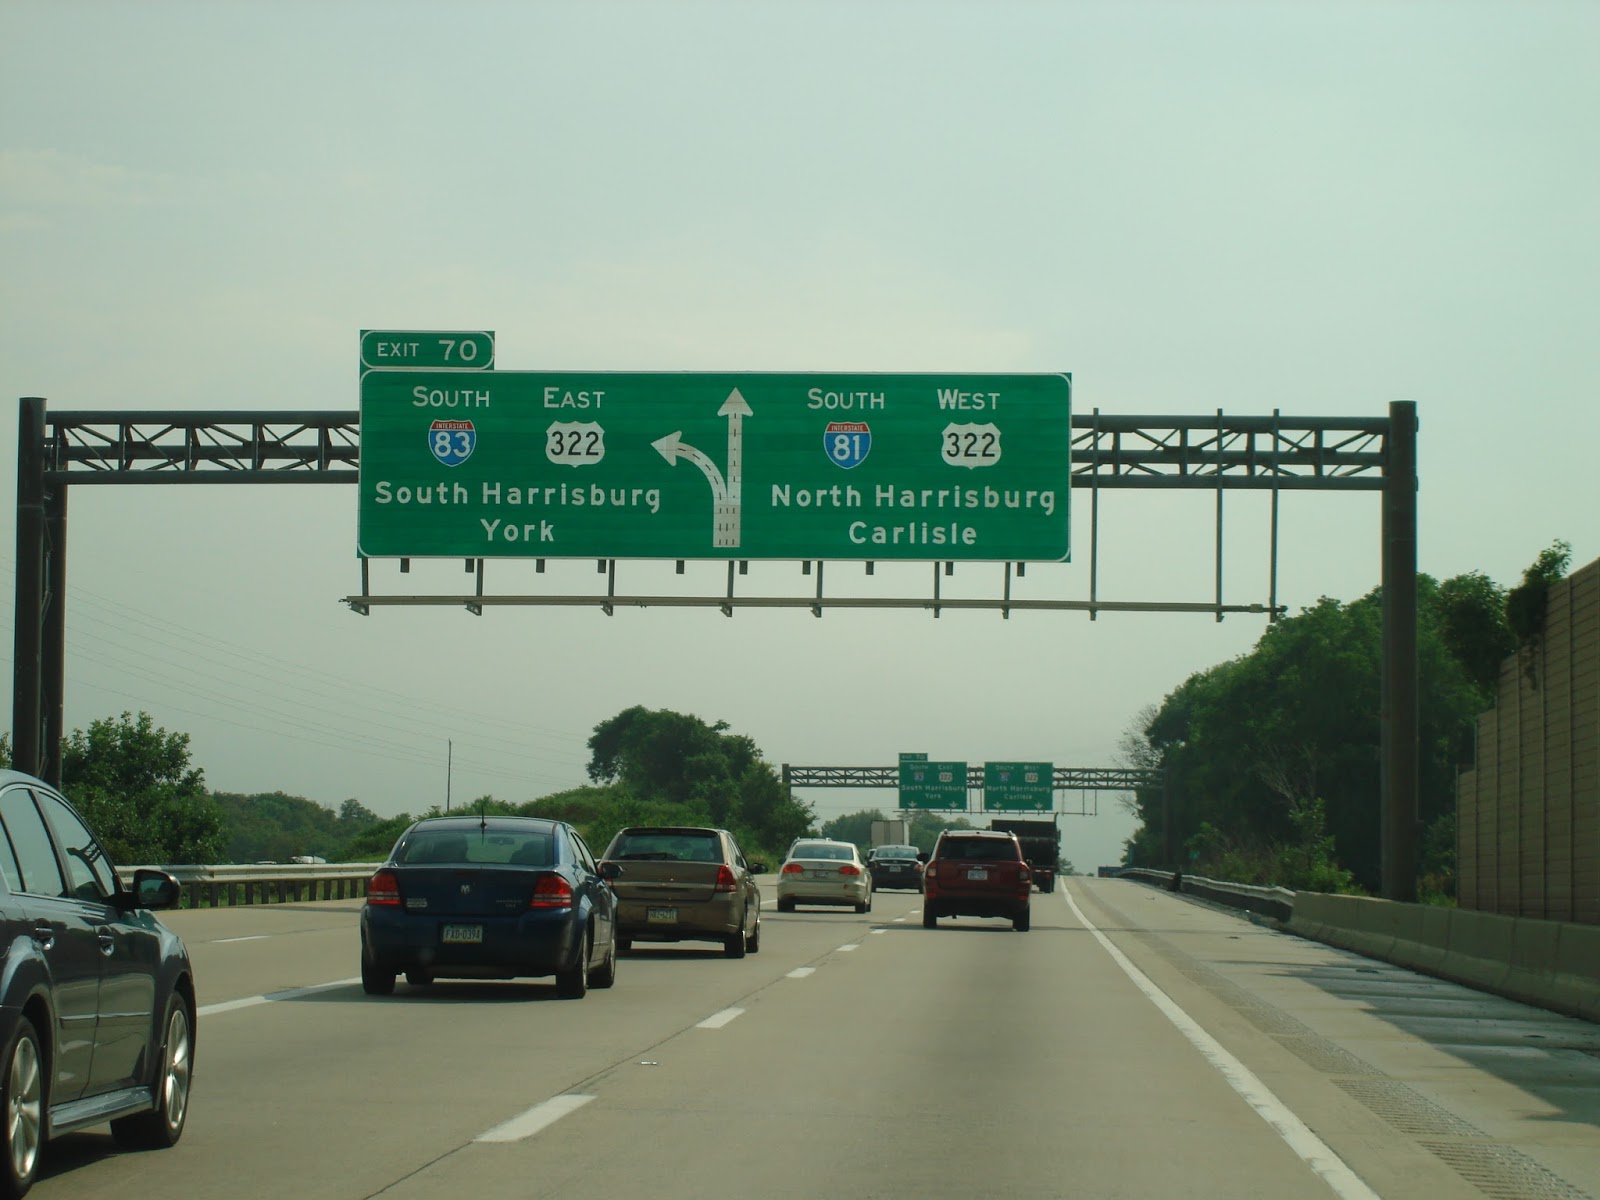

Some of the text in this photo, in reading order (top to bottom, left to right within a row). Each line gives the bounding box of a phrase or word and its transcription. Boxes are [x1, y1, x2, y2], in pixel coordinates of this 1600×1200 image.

[377, 340, 477, 361] EXIT 70
[412, 386, 490, 407] SOUTH
[543, 387, 605, 409] EAST
[807, 388, 885, 410] SOUTH
[937, 389, 1000, 410] WEST
[434, 431, 470, 457] 83
[550, 431, 600, 456] 322
[833, 434, 860, 460] 81
[946, 433, 996, 457] 322
[375, 481, 661, 514] South Harrisburg
[771, 484, 1055, 516] North Harrisburg
[480, 518, 554, 542] York
[849, 521, 977, 545] Carlisle
[925, 784, 965, 792] Harrisburg
